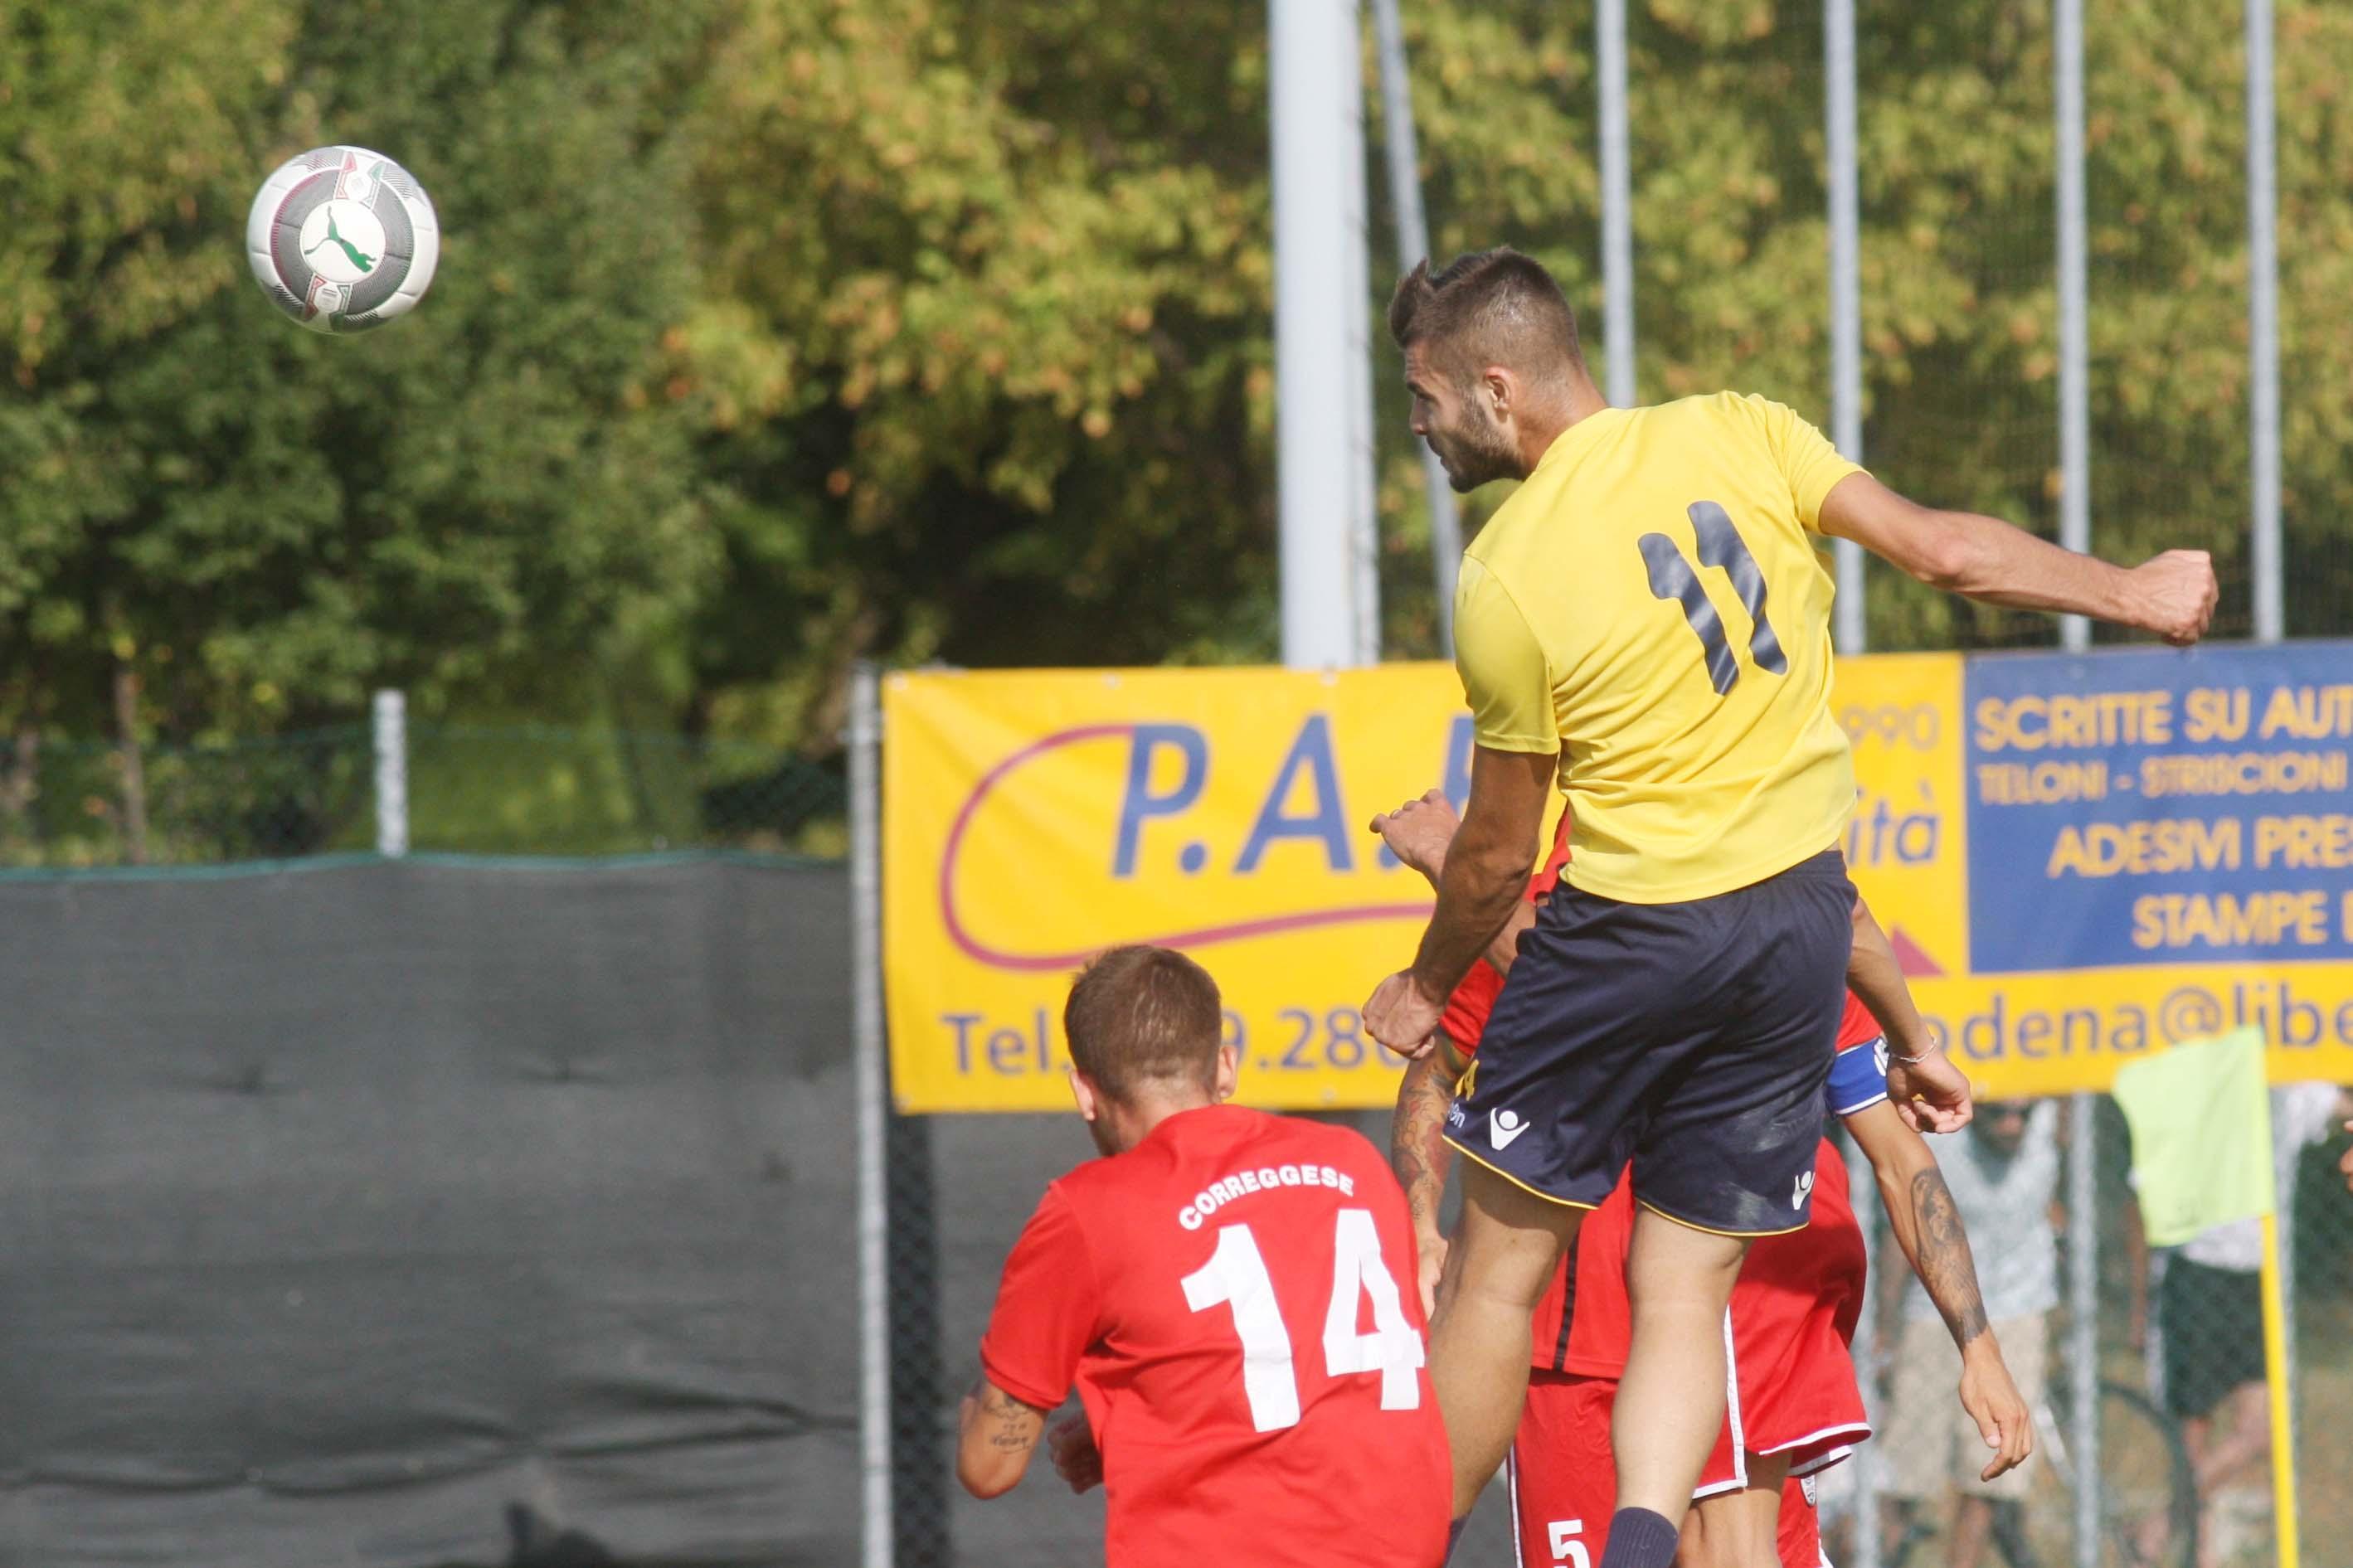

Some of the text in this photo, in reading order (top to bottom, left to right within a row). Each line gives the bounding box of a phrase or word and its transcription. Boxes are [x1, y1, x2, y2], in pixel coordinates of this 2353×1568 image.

[1638, 500, 1787, 696] 11
[1976, 692, 2172, 751] SCRITTE
[2184, 687, 2250, 741] SU
[1979, 760, 2107, 806] TELONI
[2142, 750, 2348, 798] STRISCIONI
[2048, 818, 2241, 878] ADESIVI
[2132, 890, 2328, 949] STAMPE
[1179, 1164, 1354, 1231] CORREGGESE
[1180, 1208, 1426, 1433] 14
[1548, 1518, 1592, 1568] 5
